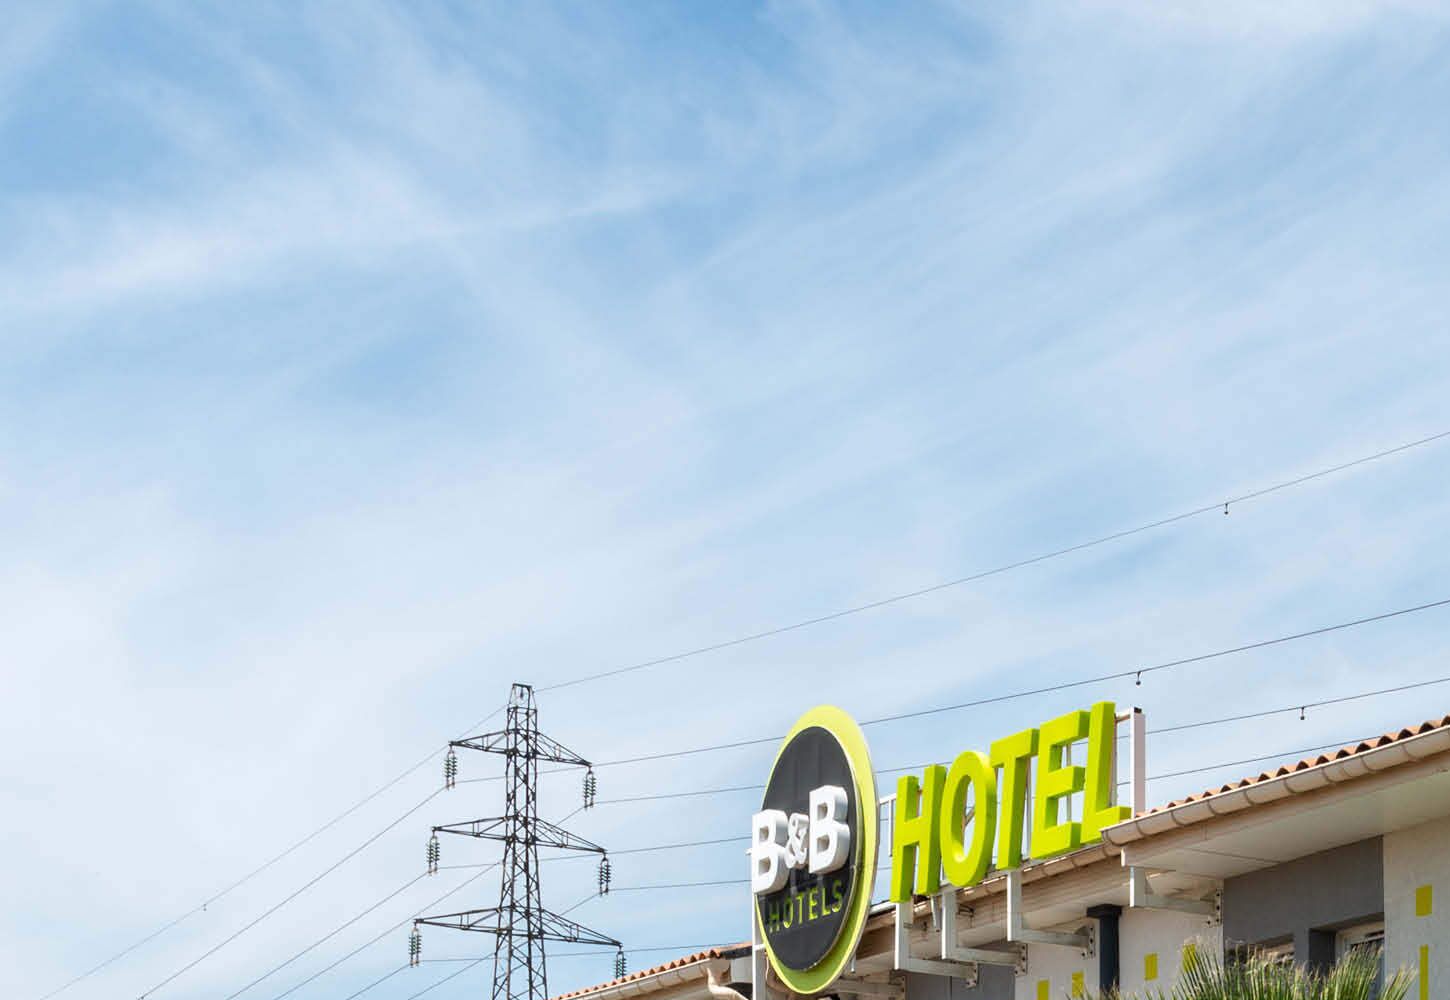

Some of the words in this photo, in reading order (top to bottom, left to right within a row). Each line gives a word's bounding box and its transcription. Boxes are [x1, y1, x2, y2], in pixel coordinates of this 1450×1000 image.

[752, 785, 850, 894] B&B
[890, 701, 1131, 903] HOTEL
[768, 880, 843, 933] HOTELS
